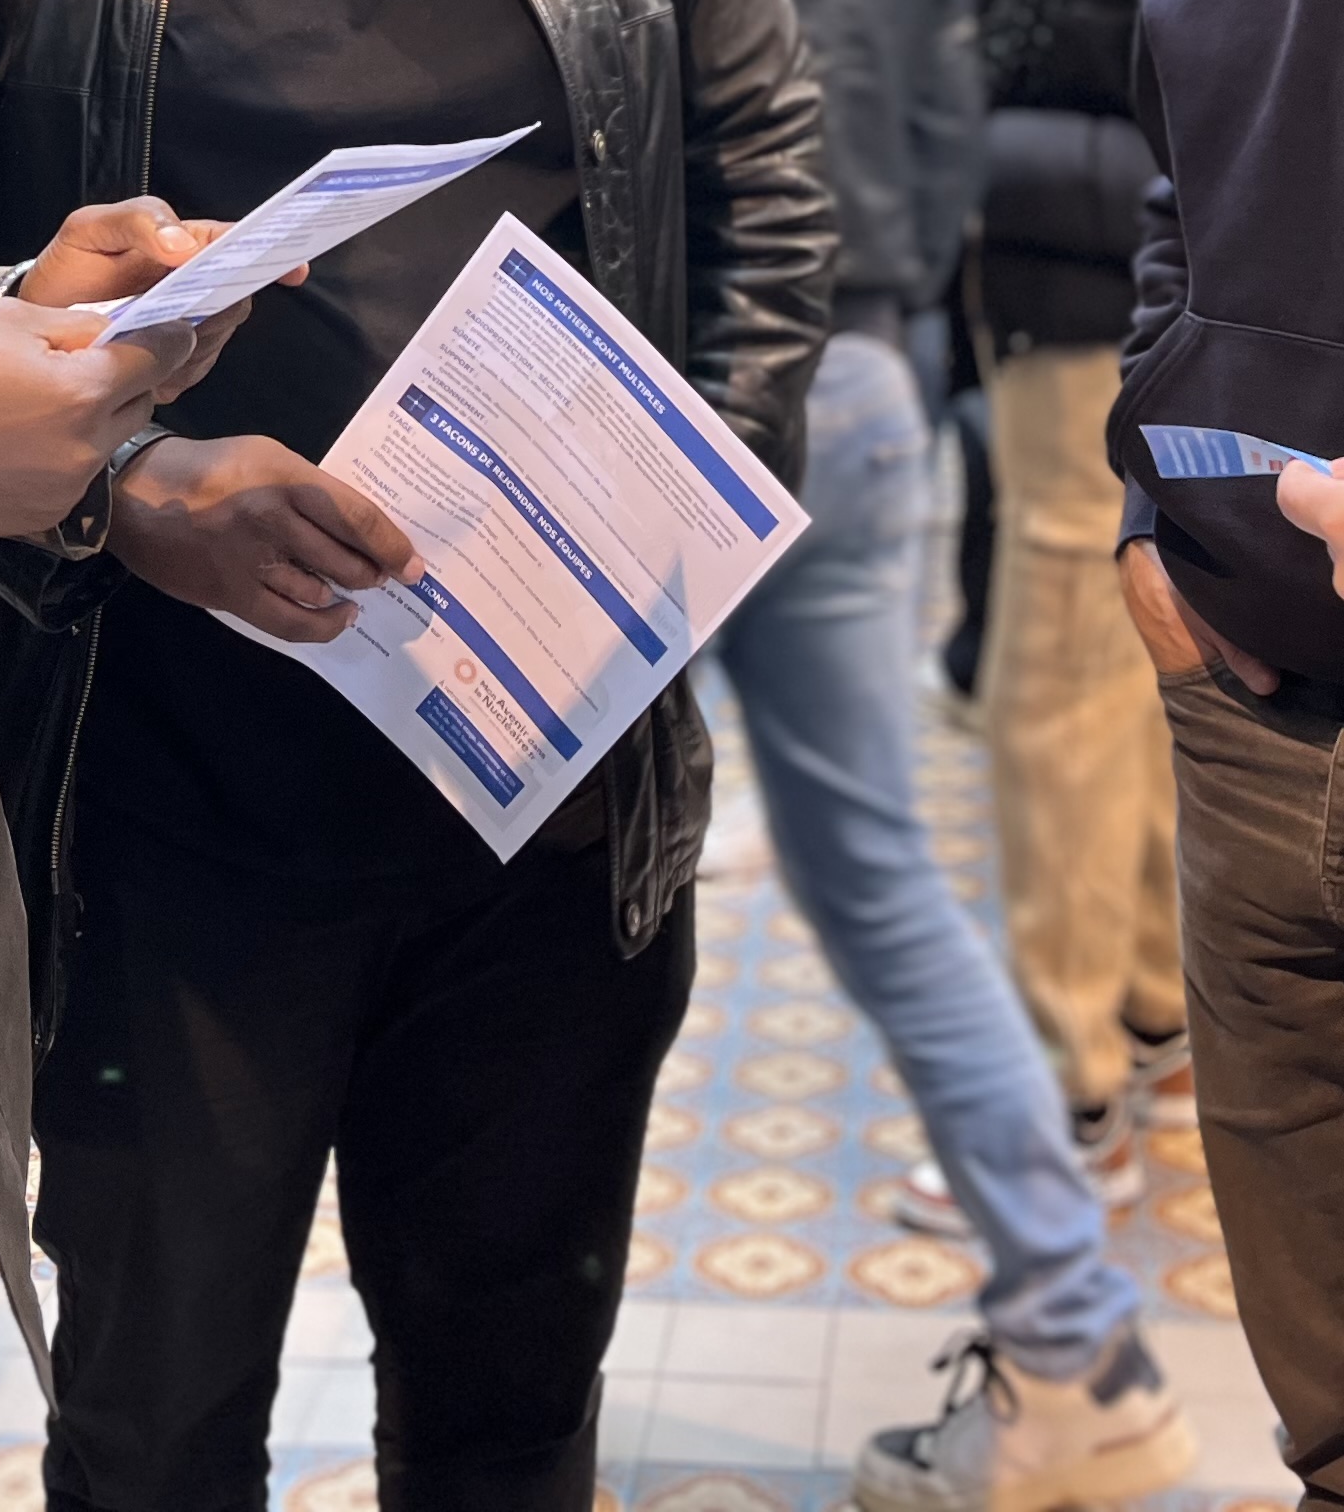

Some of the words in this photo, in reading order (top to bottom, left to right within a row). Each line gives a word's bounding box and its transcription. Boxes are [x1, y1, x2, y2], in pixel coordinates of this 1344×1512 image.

[451, 324, 481, 352] SÛRETÉ
[492, 270, 544, 318] EXPLOITATION
[544, 317, 597, 369] MAINTENANCE
[530, 278, 555, 302] NOS
[552, 299, 594, 340] MÉTIERS
[590, 335, 620, 364] SONT
[616, 361, 667, 414] MULTIPLES
[439, 343, 474, 374] SUPPORT
[464, 308, 534, 371] RADIOPROTECTION
[536, 373, 572, 408] SÉCURITÉ
[388, 410, 412, 433] STAGE
[421, 367, 485, 421] ENVIRONNEMENT
[351, 457, 398, 500] ALTERNANCE
[428, 413, 440, 424] 3
[436, 420, 479, 458] FAÇONS
[477, 453, 493, 468] DE
[491, 465, 539, 517] REJOINDRE
[536, 515, 559, 540] NOS
[554, 536, 593, 580] ÉQUIPES
[478, 680, 498, 700] Mon
[495, 697, 530, 737] Avenir
[526, 737, 547, 759] dans
